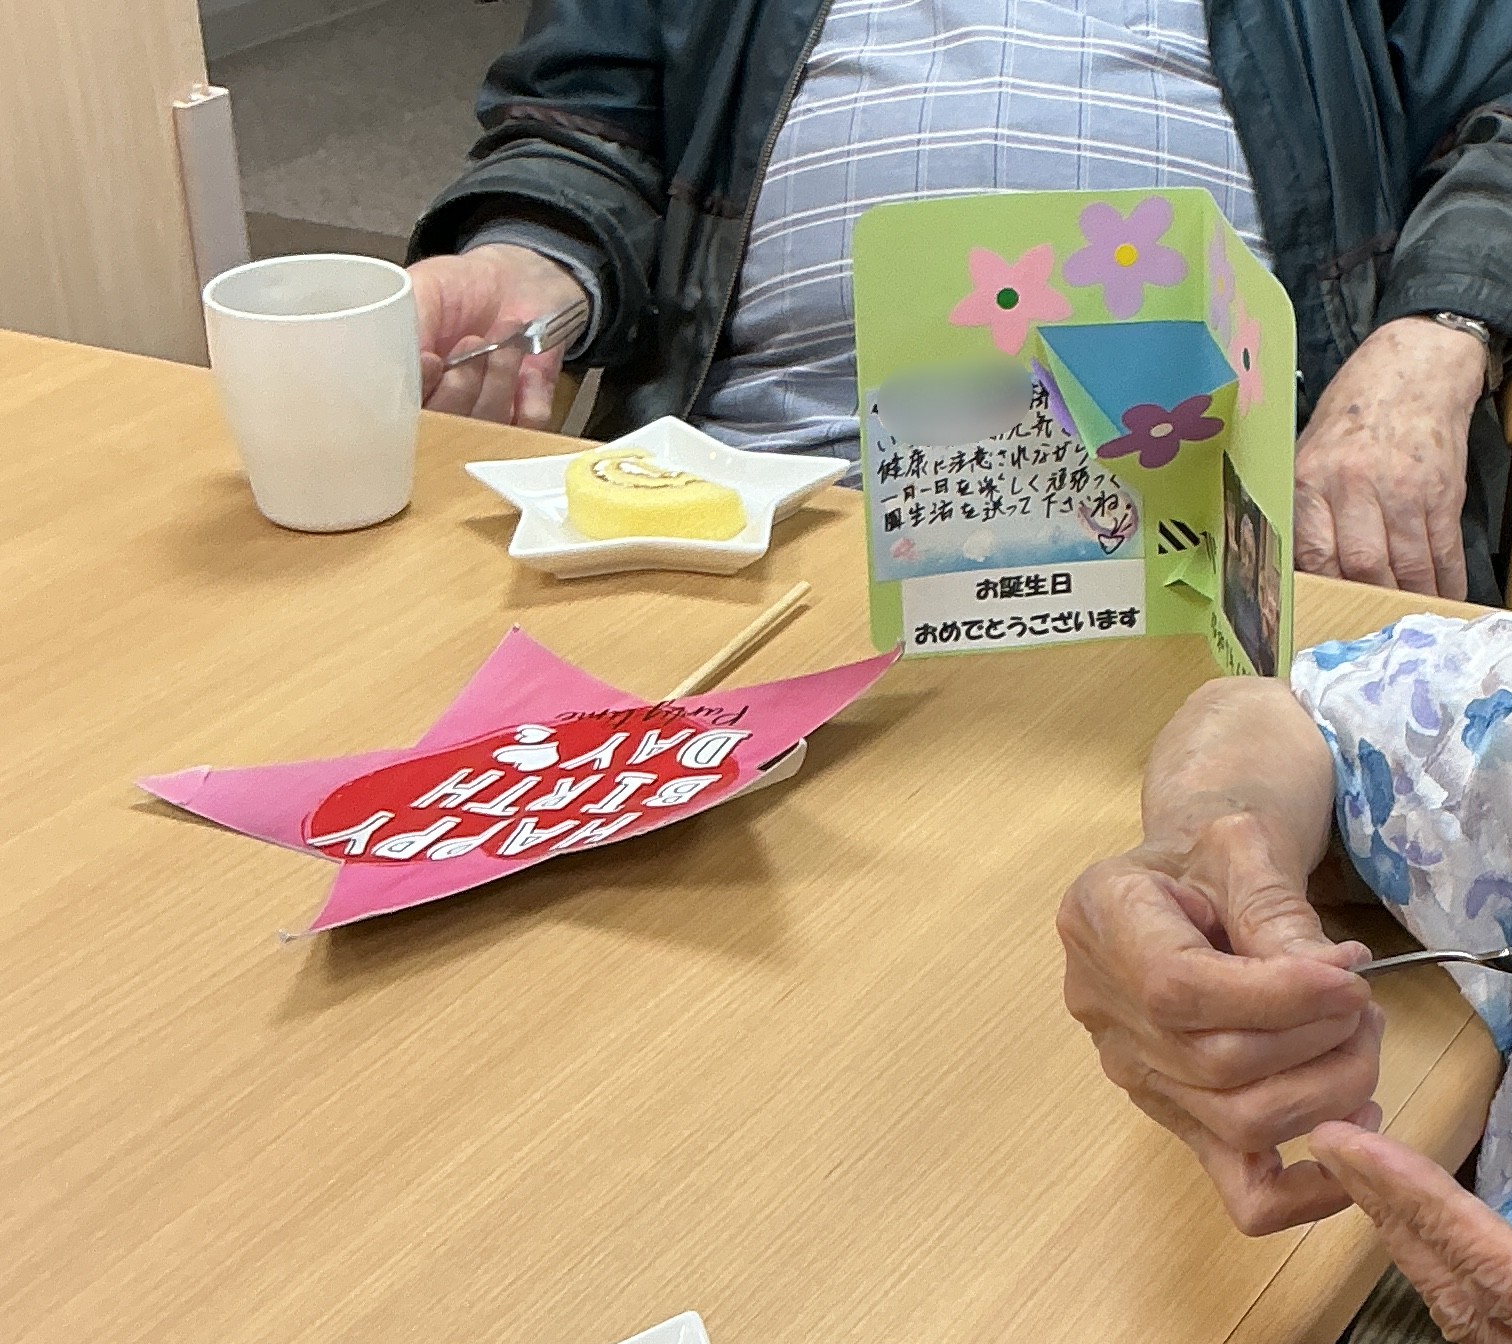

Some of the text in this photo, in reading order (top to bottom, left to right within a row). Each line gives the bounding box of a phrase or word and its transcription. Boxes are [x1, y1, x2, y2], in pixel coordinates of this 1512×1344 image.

[976, 572, 1072, 600] お誕生日
[915, 606, 1140, 644] おめでとうございます
[643, 700, 750, 727] Party
[557, 729, 753, 772] DAY
[410, 768, 722, 817] BIRTH
[307, 810, 643, 861] HAPPY
